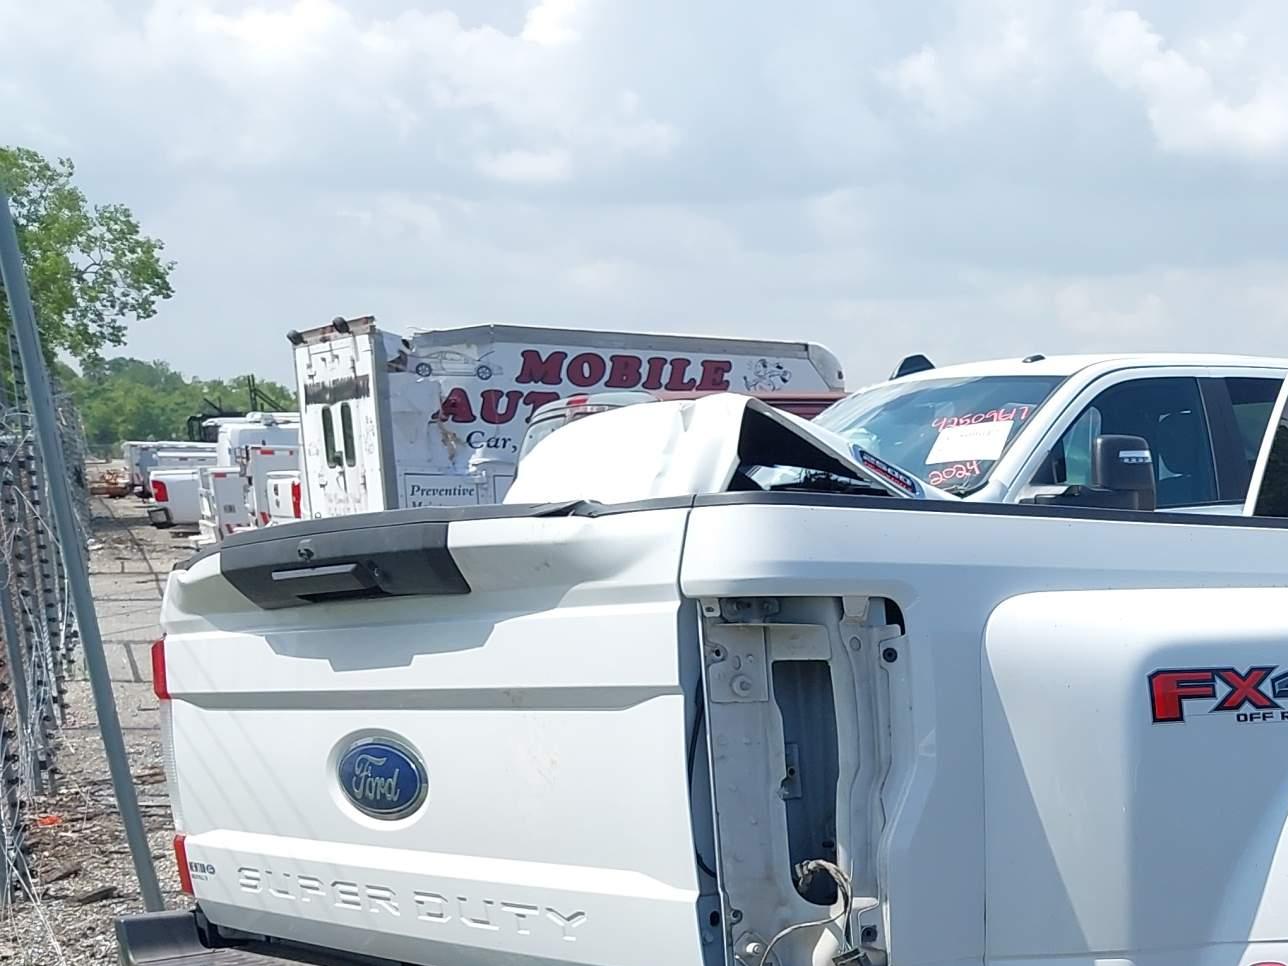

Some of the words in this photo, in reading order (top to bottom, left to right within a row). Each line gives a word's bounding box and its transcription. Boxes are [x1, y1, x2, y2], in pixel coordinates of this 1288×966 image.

[515, 349, 732, 391] MOBILE
[430, 387, 593, 425] AUT
[466, 430, 518, 453] Car,
[928, 460, 980, 486] 2024
[410, 484, 475, 497] Preventive
[1236, 711, 1275, 723] OFF
[352, 754, 401, 802] Ford
[236, 866, 400, 917] SUPER
[412, 890, 588, 941] DUTY
